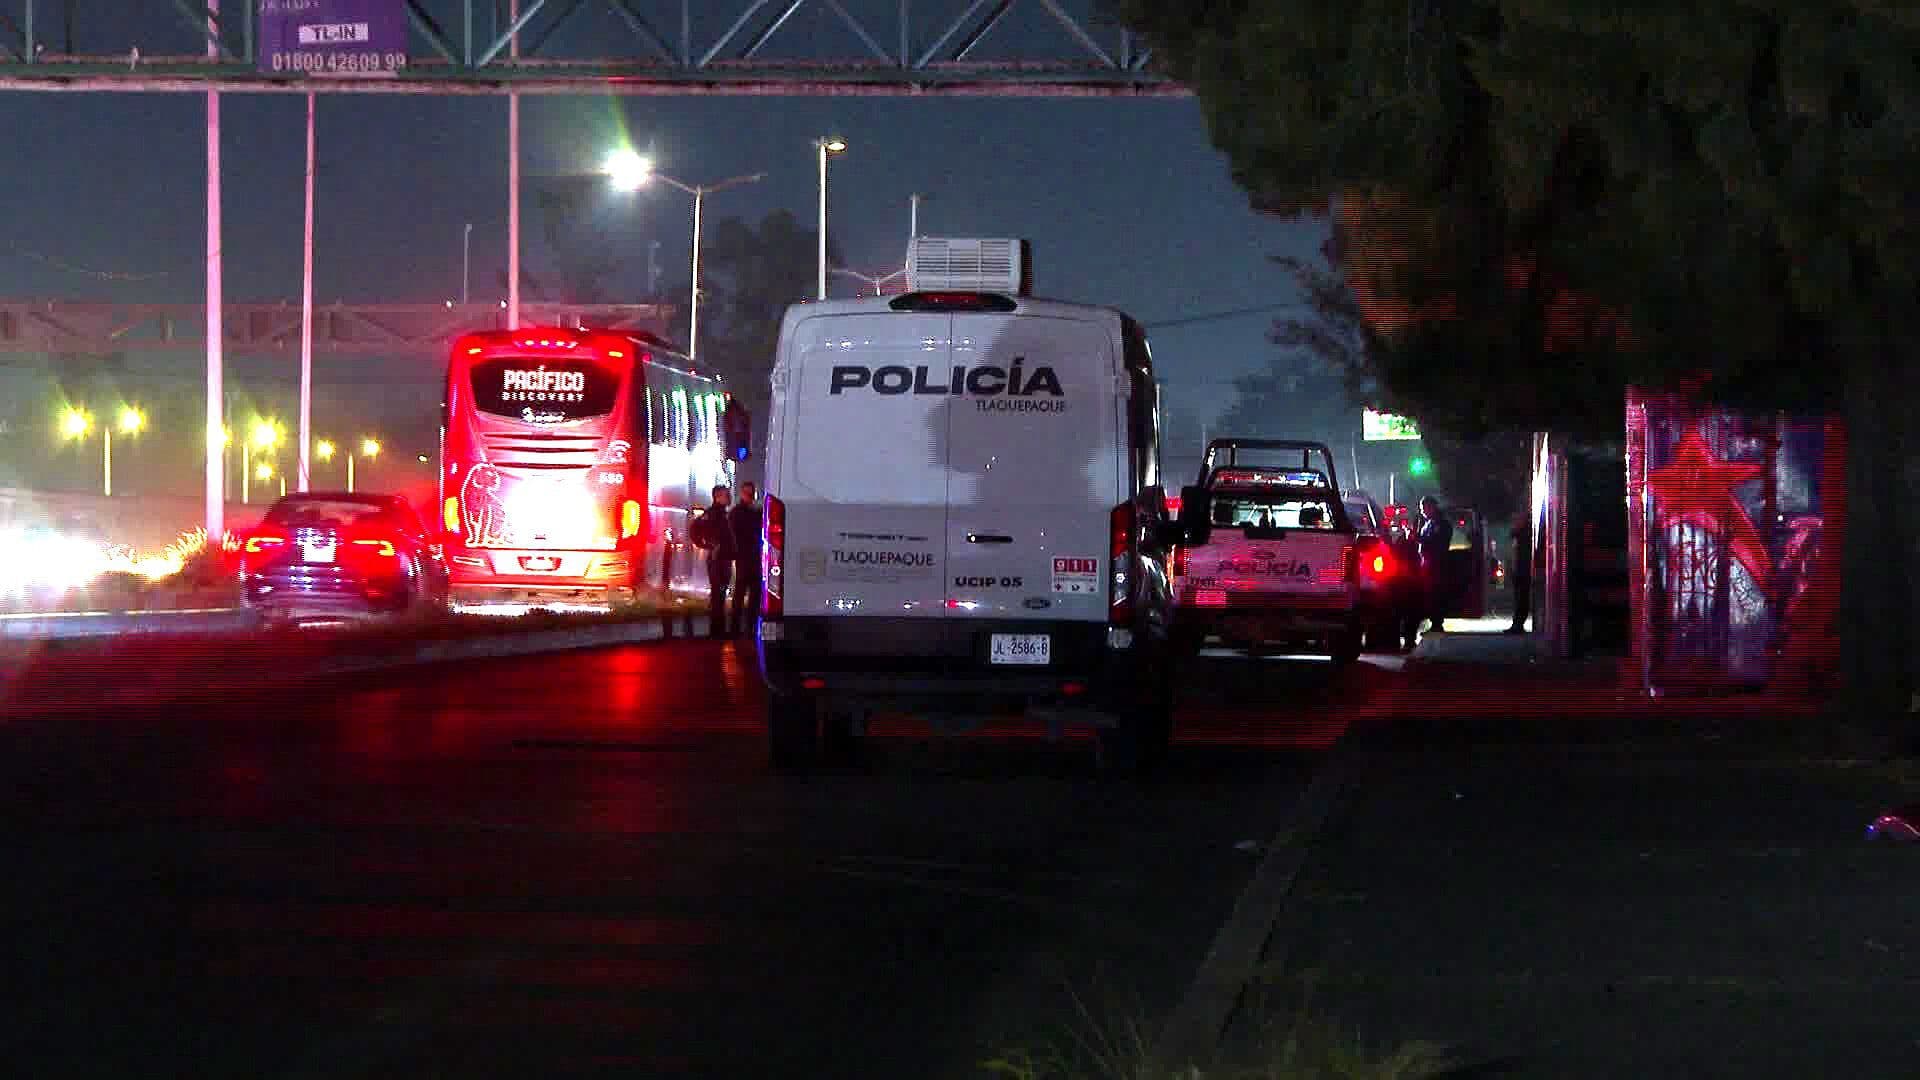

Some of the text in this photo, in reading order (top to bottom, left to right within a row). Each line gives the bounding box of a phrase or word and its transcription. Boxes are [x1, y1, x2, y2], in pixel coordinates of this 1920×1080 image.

[503, 365, 585, 391] PACÍFICO
[830, 357, 1065, 396] POLICÍA
[501, 391, 585, 401] DISCOVERY
[975, 400, 1065, 413] TLAQUEPAQUE
[832, 550, 937, 567] TLAQUEPAQUE
[1056, 560, 1095, 571] 911
[955, 576, 1023, 588] UCIP 05
